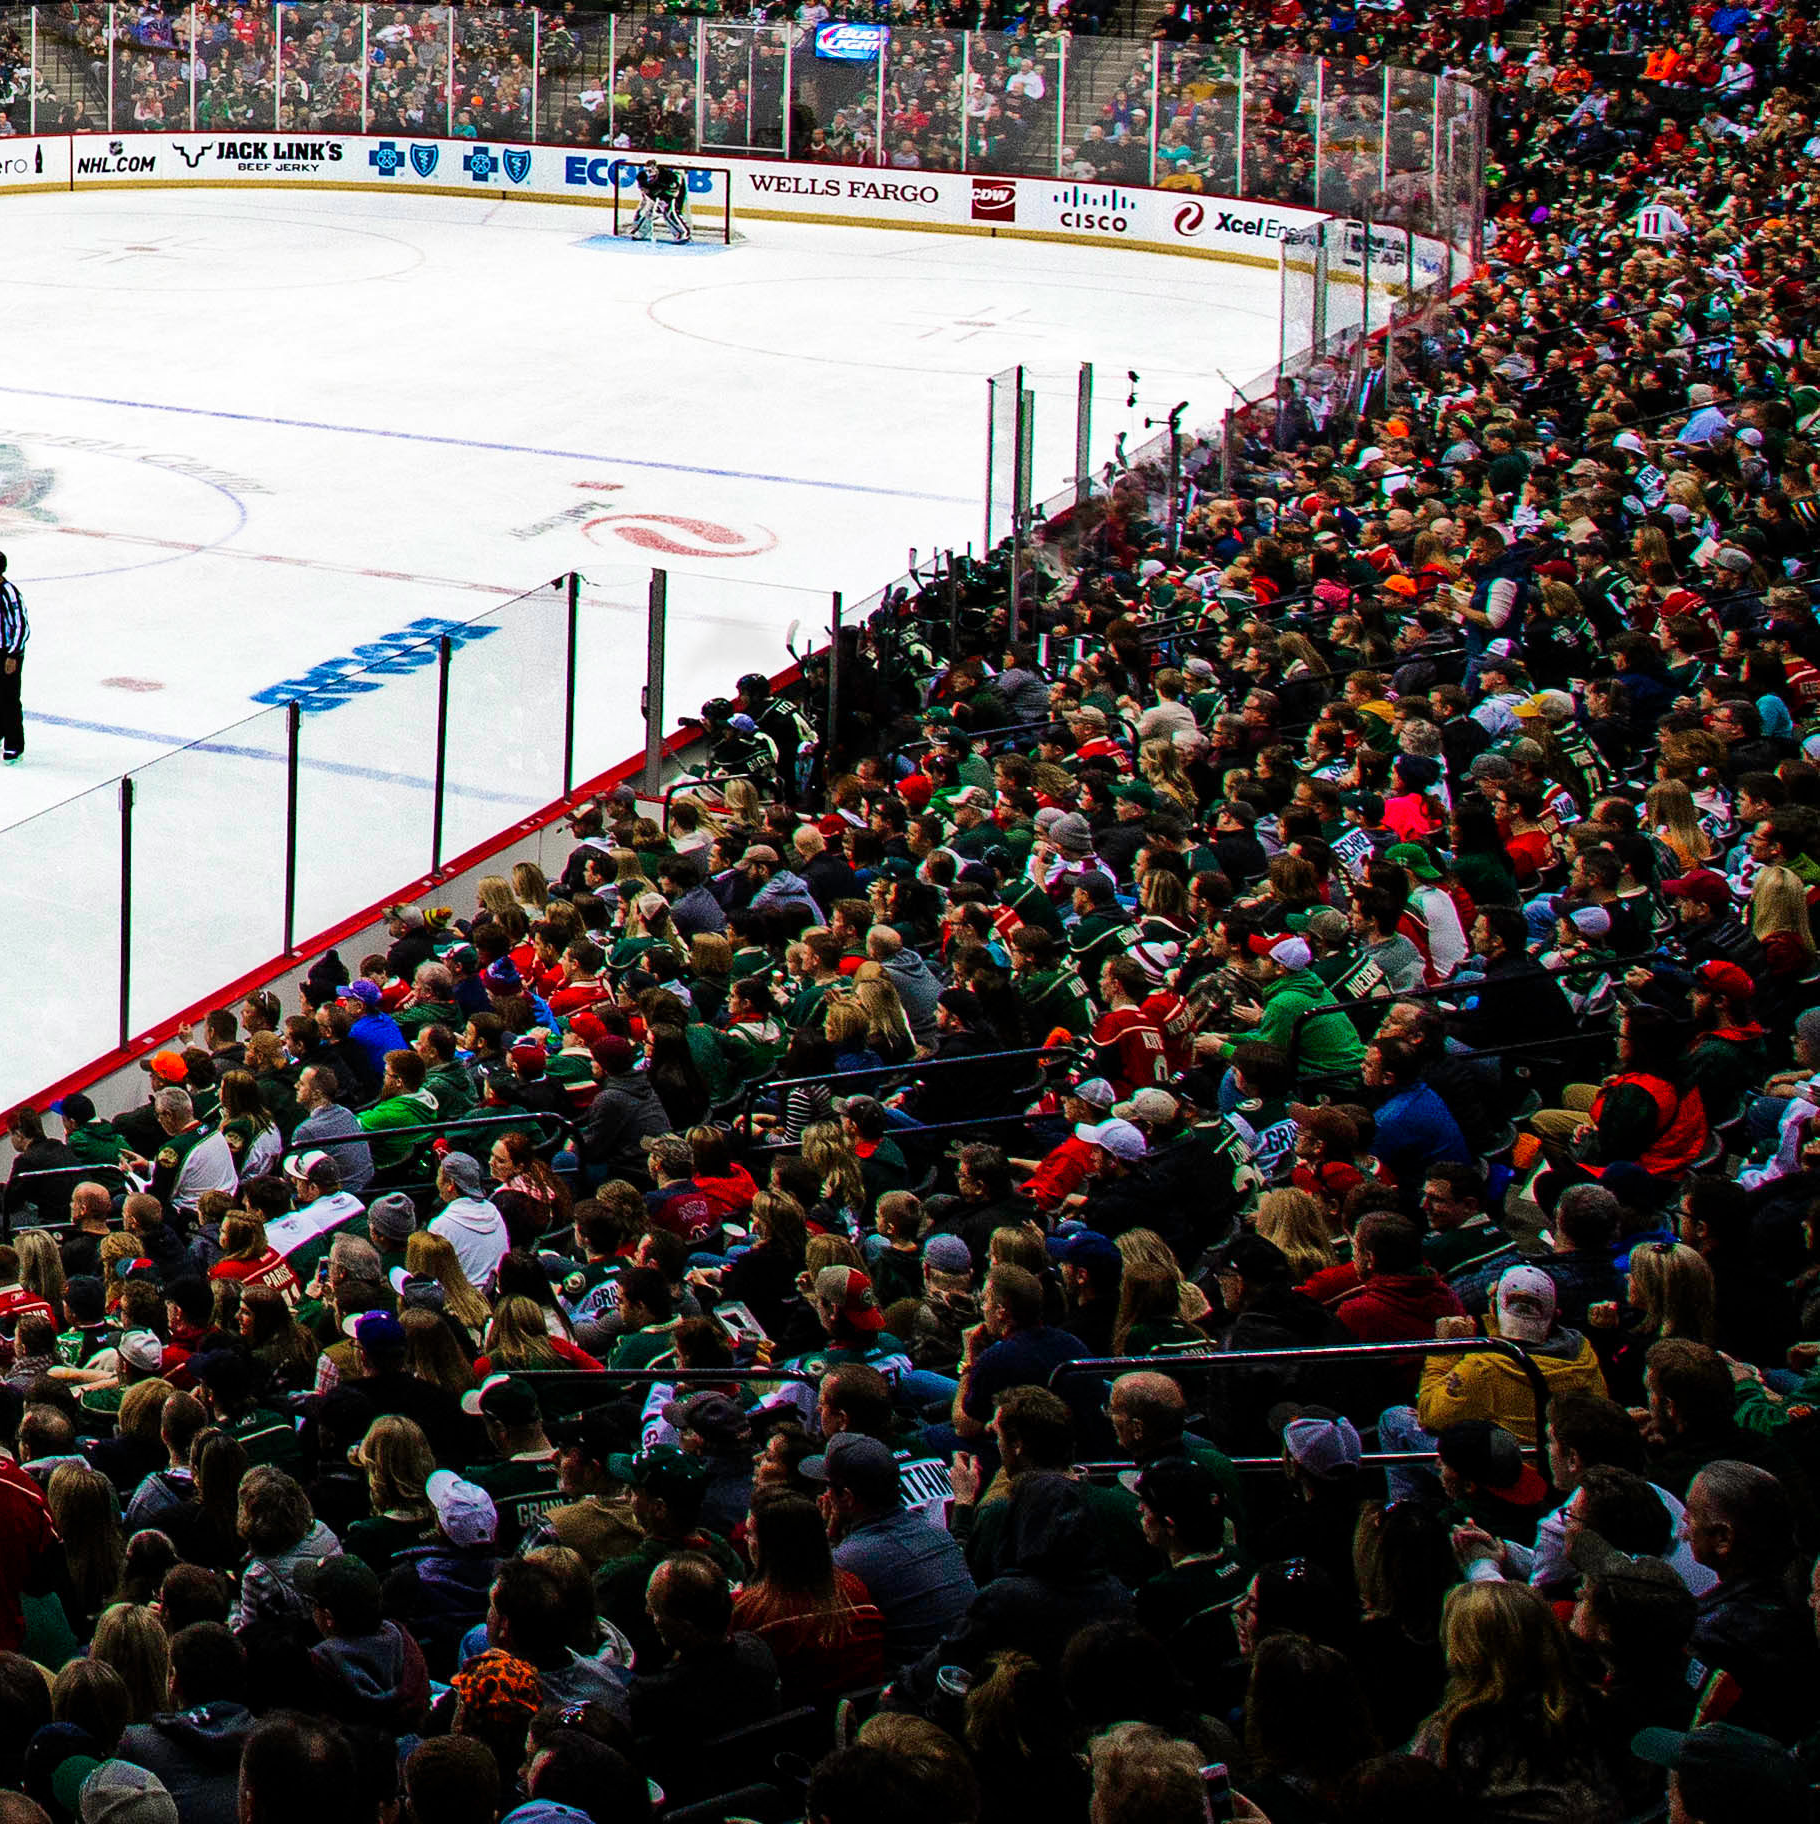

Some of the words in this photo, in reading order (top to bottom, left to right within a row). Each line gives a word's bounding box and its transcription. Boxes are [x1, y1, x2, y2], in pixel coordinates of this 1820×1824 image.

[216, 140, 268, 160] JACK
[272, 140, 343, 164] LINK'S
[76, 155, 157, 175] NHL.COM
[237, 162, 272, 172] BEEF
[274, 162, 320, 173] JERKY
[749, 173, 842, 198] WELLS
[847, 179, 940, 205] FARGO
[971, 186, 1012, 203] CDW
[1061, 210, 1129, 233] CISCO
[1214, 211, 1264, 237] Xcel
[248, 616, 503, 714] ECOLAB
